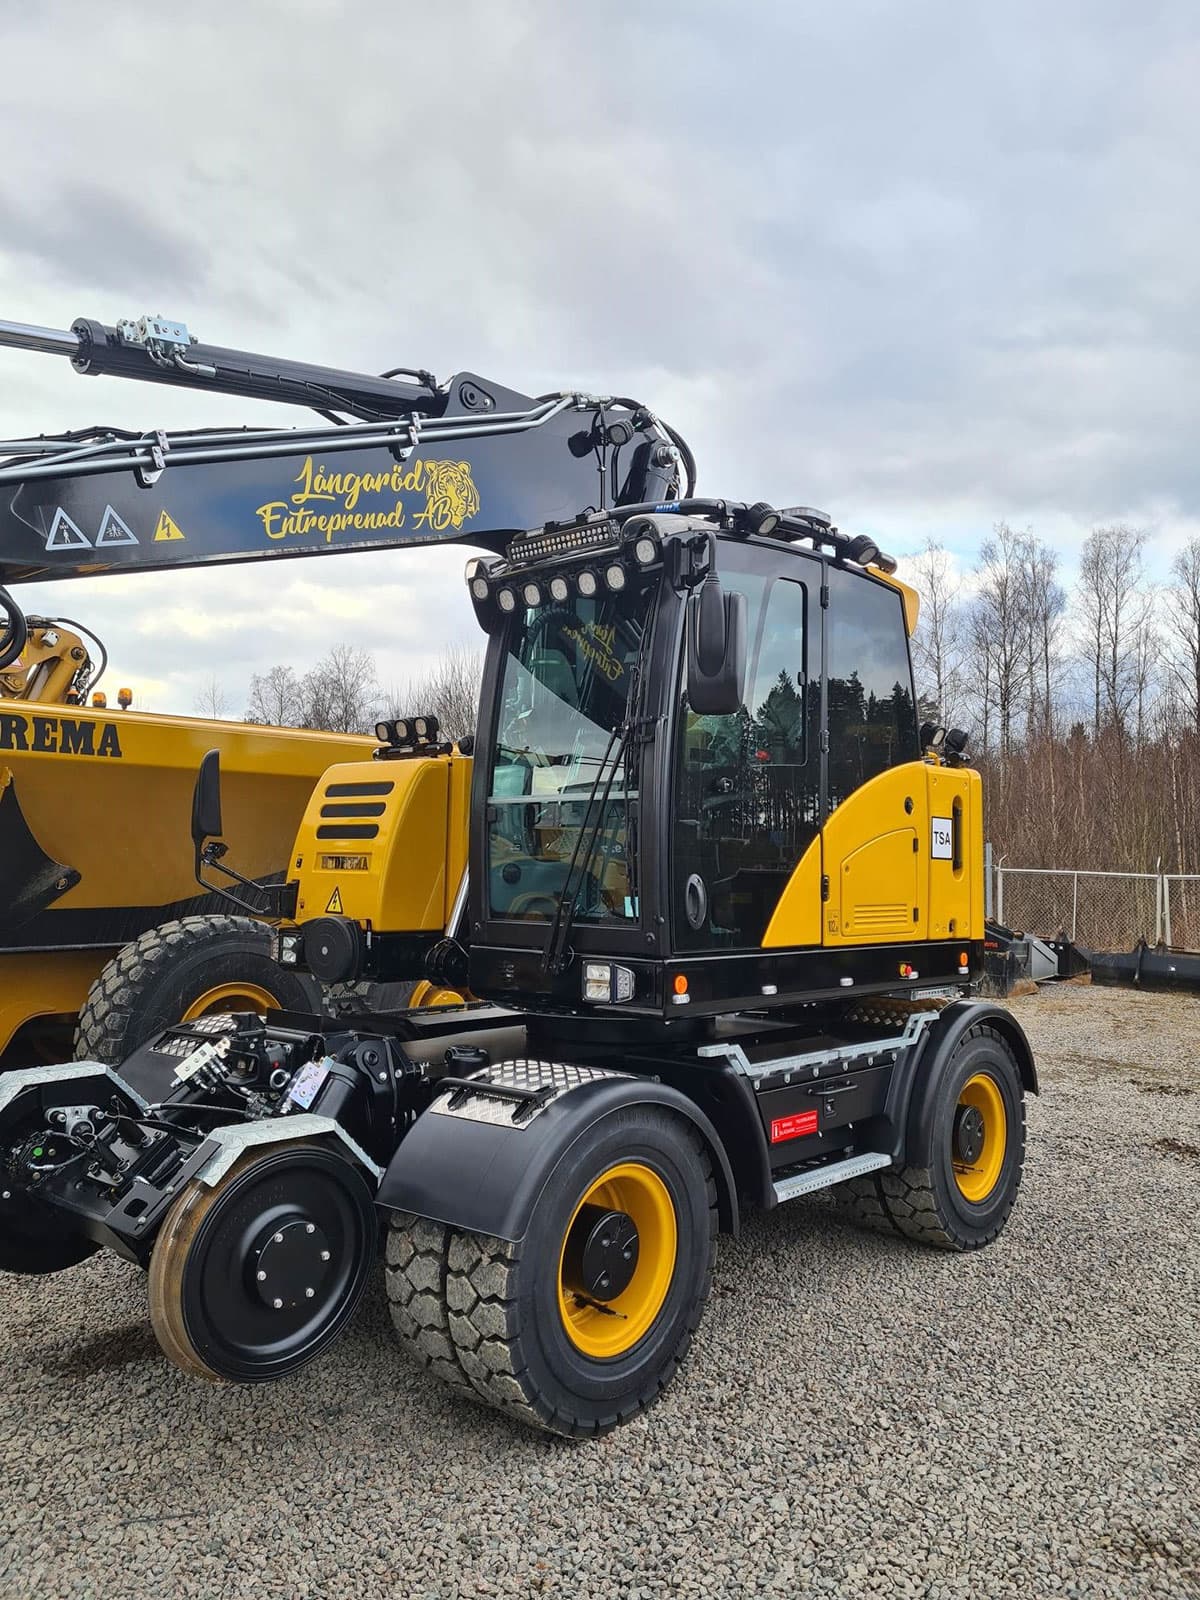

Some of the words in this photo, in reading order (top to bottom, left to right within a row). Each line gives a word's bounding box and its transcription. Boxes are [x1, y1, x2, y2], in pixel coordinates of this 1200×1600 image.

[291, 456, 425, 510] Långaröd
[256, 501, 405, 543] Entreprenad
[411, 496, 453, 531] AB
[0, 714, 122, 757] REMA
[933, 831, 951, 845] TSA
